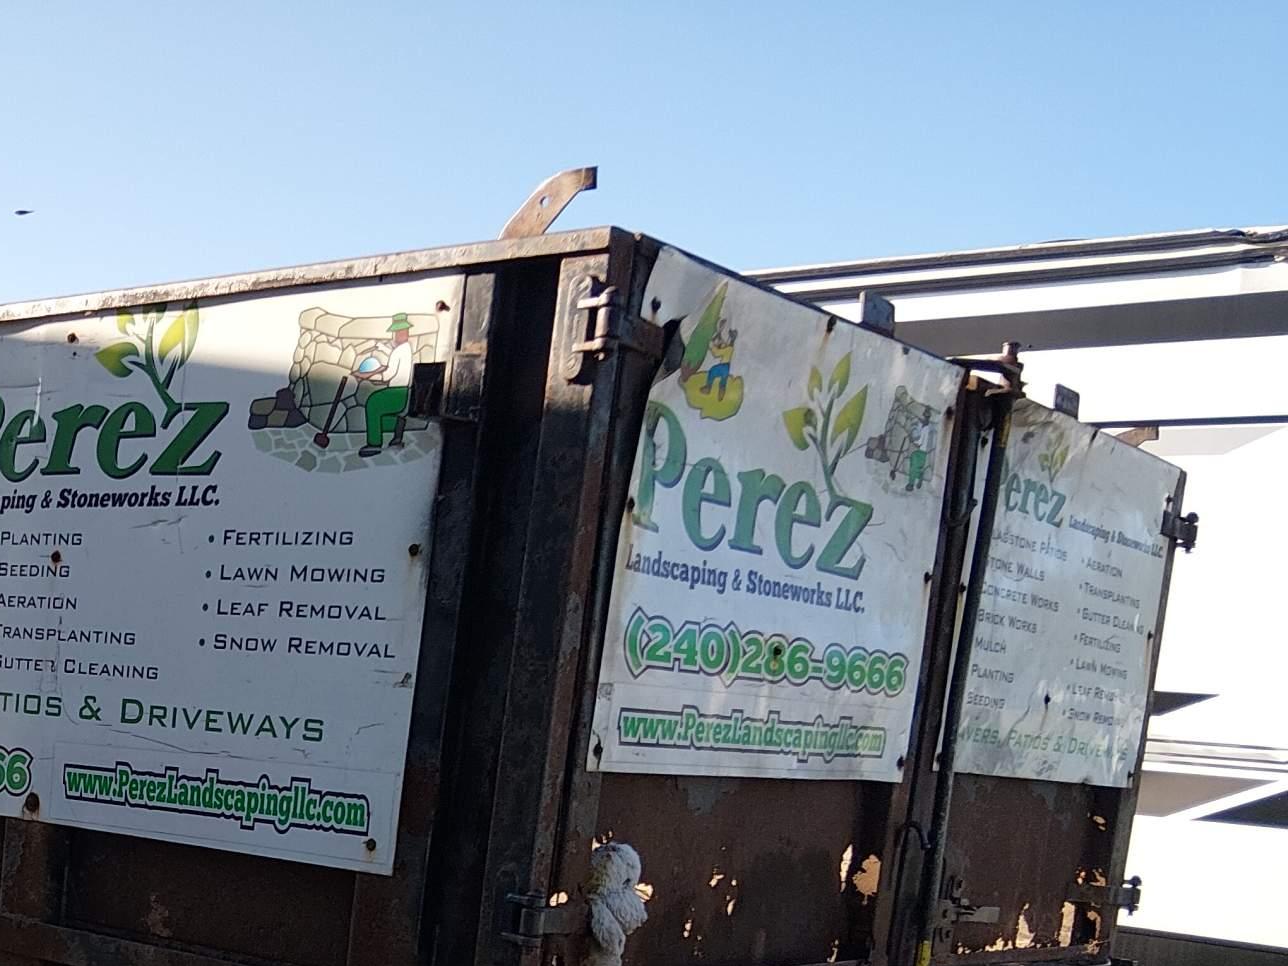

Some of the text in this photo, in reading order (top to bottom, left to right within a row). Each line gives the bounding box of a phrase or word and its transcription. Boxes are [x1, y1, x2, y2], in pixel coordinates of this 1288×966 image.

[41, 490, 53, 510] &
[56, 485, 172, 508] Stoneworks
[175, 484, 221, 507] LLC.
[632, 400, 874, 581] Perez
[0, 531, 83, 546] PLANTING
[223, 529, 354, 546] FERTILIZING
[220, 565, 385, 583] LAWN MOWING
[989, 557, 1014, 573] TONE
[626, 544, 865, 614] Landscaping & Stoneworks LLC.
[216, 599, 387, 620] LEAF REMOVAL
[213, 634, 396, 659] SNOW REMOVAL
[626, 609, 907, 695] (240)286-9666
[64, 658, 159, 680] CLEANING
[79, 695, 102, 721] &
[120, 698, 324, 742] DRIVEWAYS
[65, 765, 369, 831] www.PerezLandscapingllc.com
